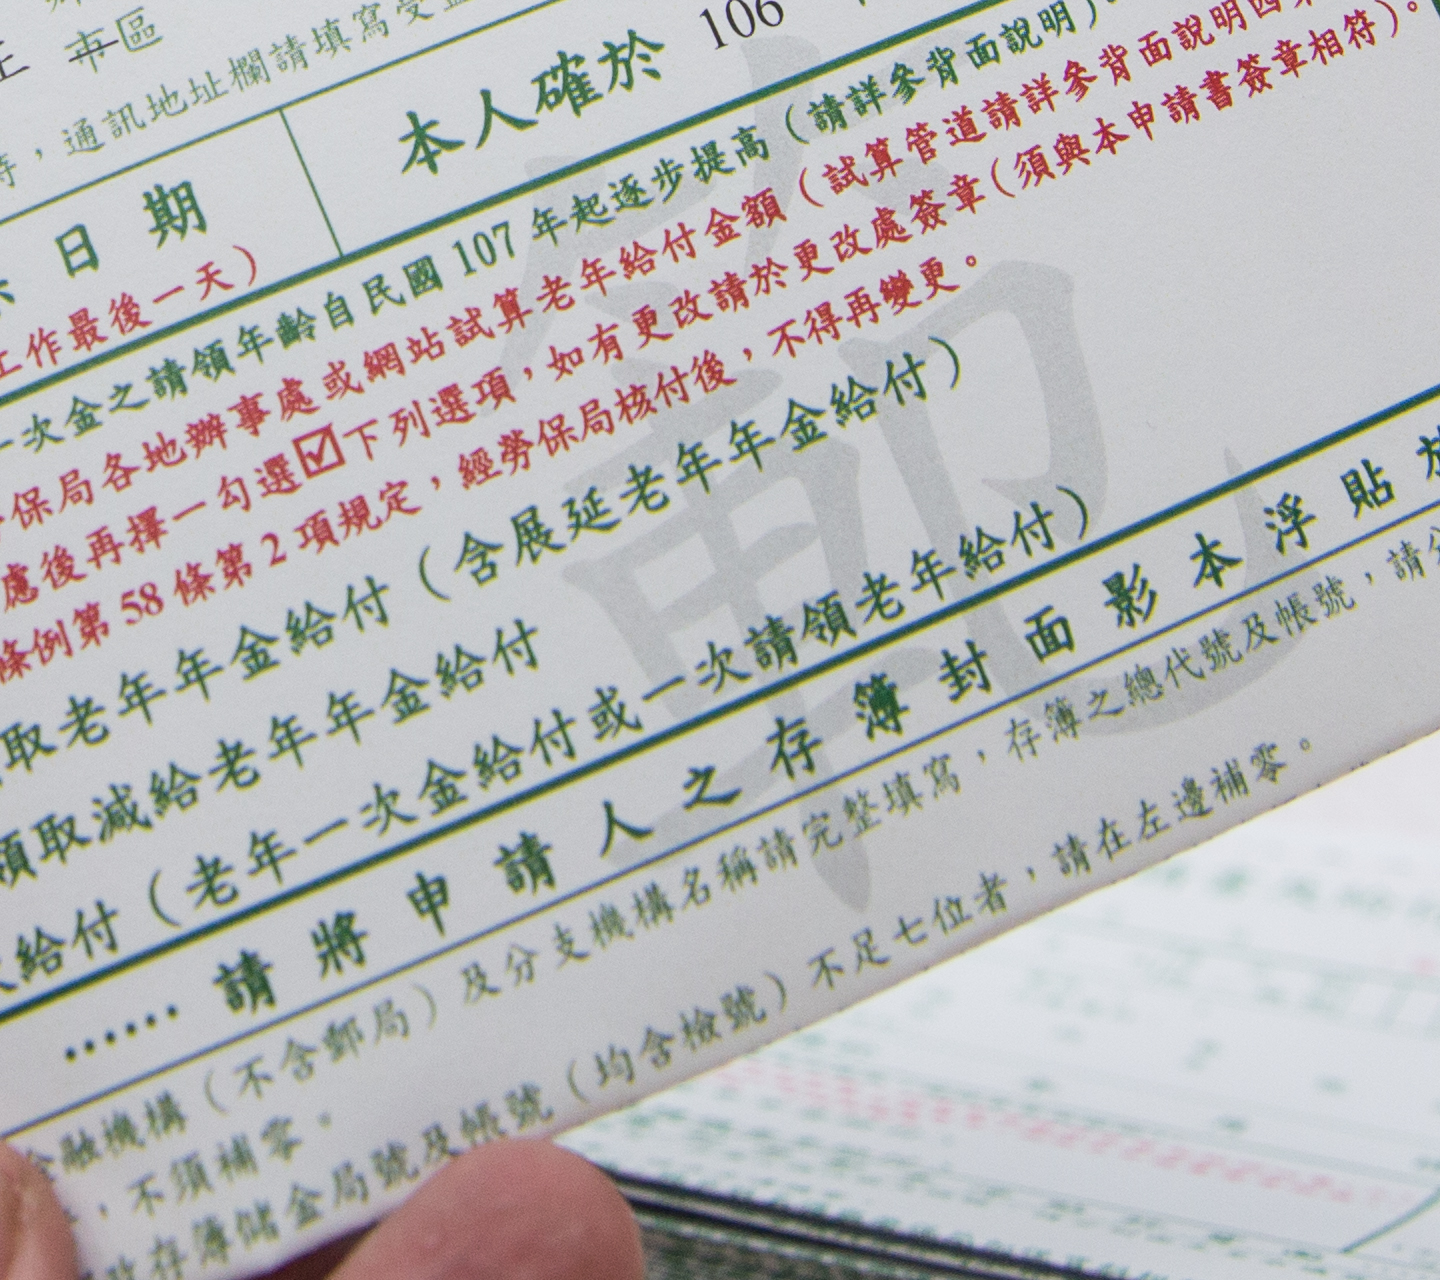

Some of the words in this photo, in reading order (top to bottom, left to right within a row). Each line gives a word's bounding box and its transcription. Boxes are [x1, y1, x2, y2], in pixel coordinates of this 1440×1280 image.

[399, 29, 665, 176] 本人確於
[452, 221, 515, 277] 107
[121, 582, 164, 626] 58
[174, 543, 252, 607] 條第
[261, 532, 287, 567] 2
